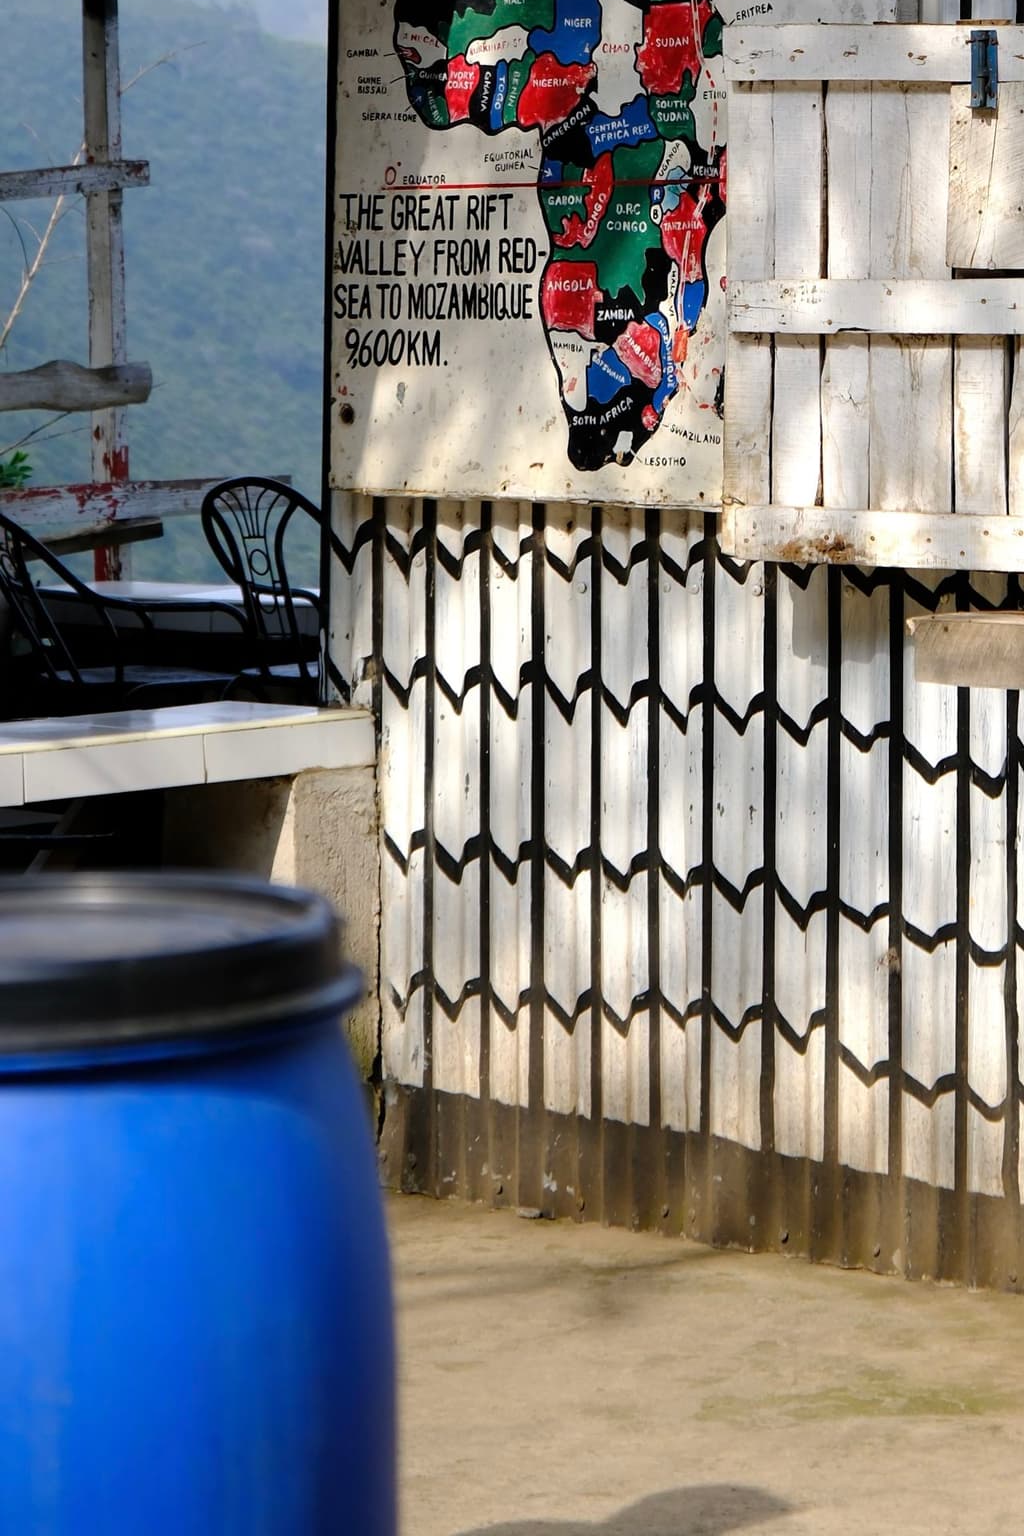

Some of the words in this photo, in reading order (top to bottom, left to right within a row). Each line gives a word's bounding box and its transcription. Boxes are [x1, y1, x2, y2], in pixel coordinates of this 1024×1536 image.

[735, 2, 774, 21] ERITREA
[563, 17, 593, 29] NIGER
[655, 36, 690, 48] SUDAN
[346, 48, 379, 58] GAMBIA
[357, 75, 382, 85] GUINE
[418, 70, 448, 82] GUINEA
[446, 79, 475, 90] COAST
[532, 78, 569, 88] NIGERIA
[357, 84, 388, 95] BISSAU
[481, 71, 492, 112] GHANA
[494, 76, 506, 111] TOGO
[508, 71, 521, 108] BENIN
[654, 99, 687, 110] SOUTH
[361, 112, 393, 122] SIERRA
[393, 112, 418, 123] LEONE
[656, 111, 690, 122] SUDAN
[541, 104, 591, 148] CAMEROON
[588, 120, 629, 134] CENTRAL
[594, 127, 630, 145] AFRICA
[483, 148, 534, 163] EQUATORIAL
[657, 141, 680, 178] UGANDA
[494, 162, 526, 173] GUINEA
[692, 165, 718, 177] KENYA
[402, 175, 446, 185] EQUATOR
[547, 195, 583, 206] GABON
[653, 188, 661, 201] R
[340, 195, 386, 230] THE
[391, 195, 460, 231] GREAT
[467, 195, 515, 230] RIFT
[583, 193, 608, 237] CONGO
[653, 208, 659, 220] B
[606, 220, 648, 233] CONGO
[663, 220, 703, 231] TANZANIA
[338, 240, 426, 276] VALLEY
[433, 240, 491, 276] FROM
[546, 278, 594, 292] ANGOLA
[333, 284, 371, 319] SEA
[376, 284, 401, 320] TO
[407, 281, 533, 320] MOZAMBIQUE
[596, 308, 635, 321] ZAMBIA
[553, 341, 585, 353] NAMIBIA
[572, 416, 597, 426] SOTH
[599, 396, 634, 425] AFRICA
[644, 457, 687, 467] LESOTHO
